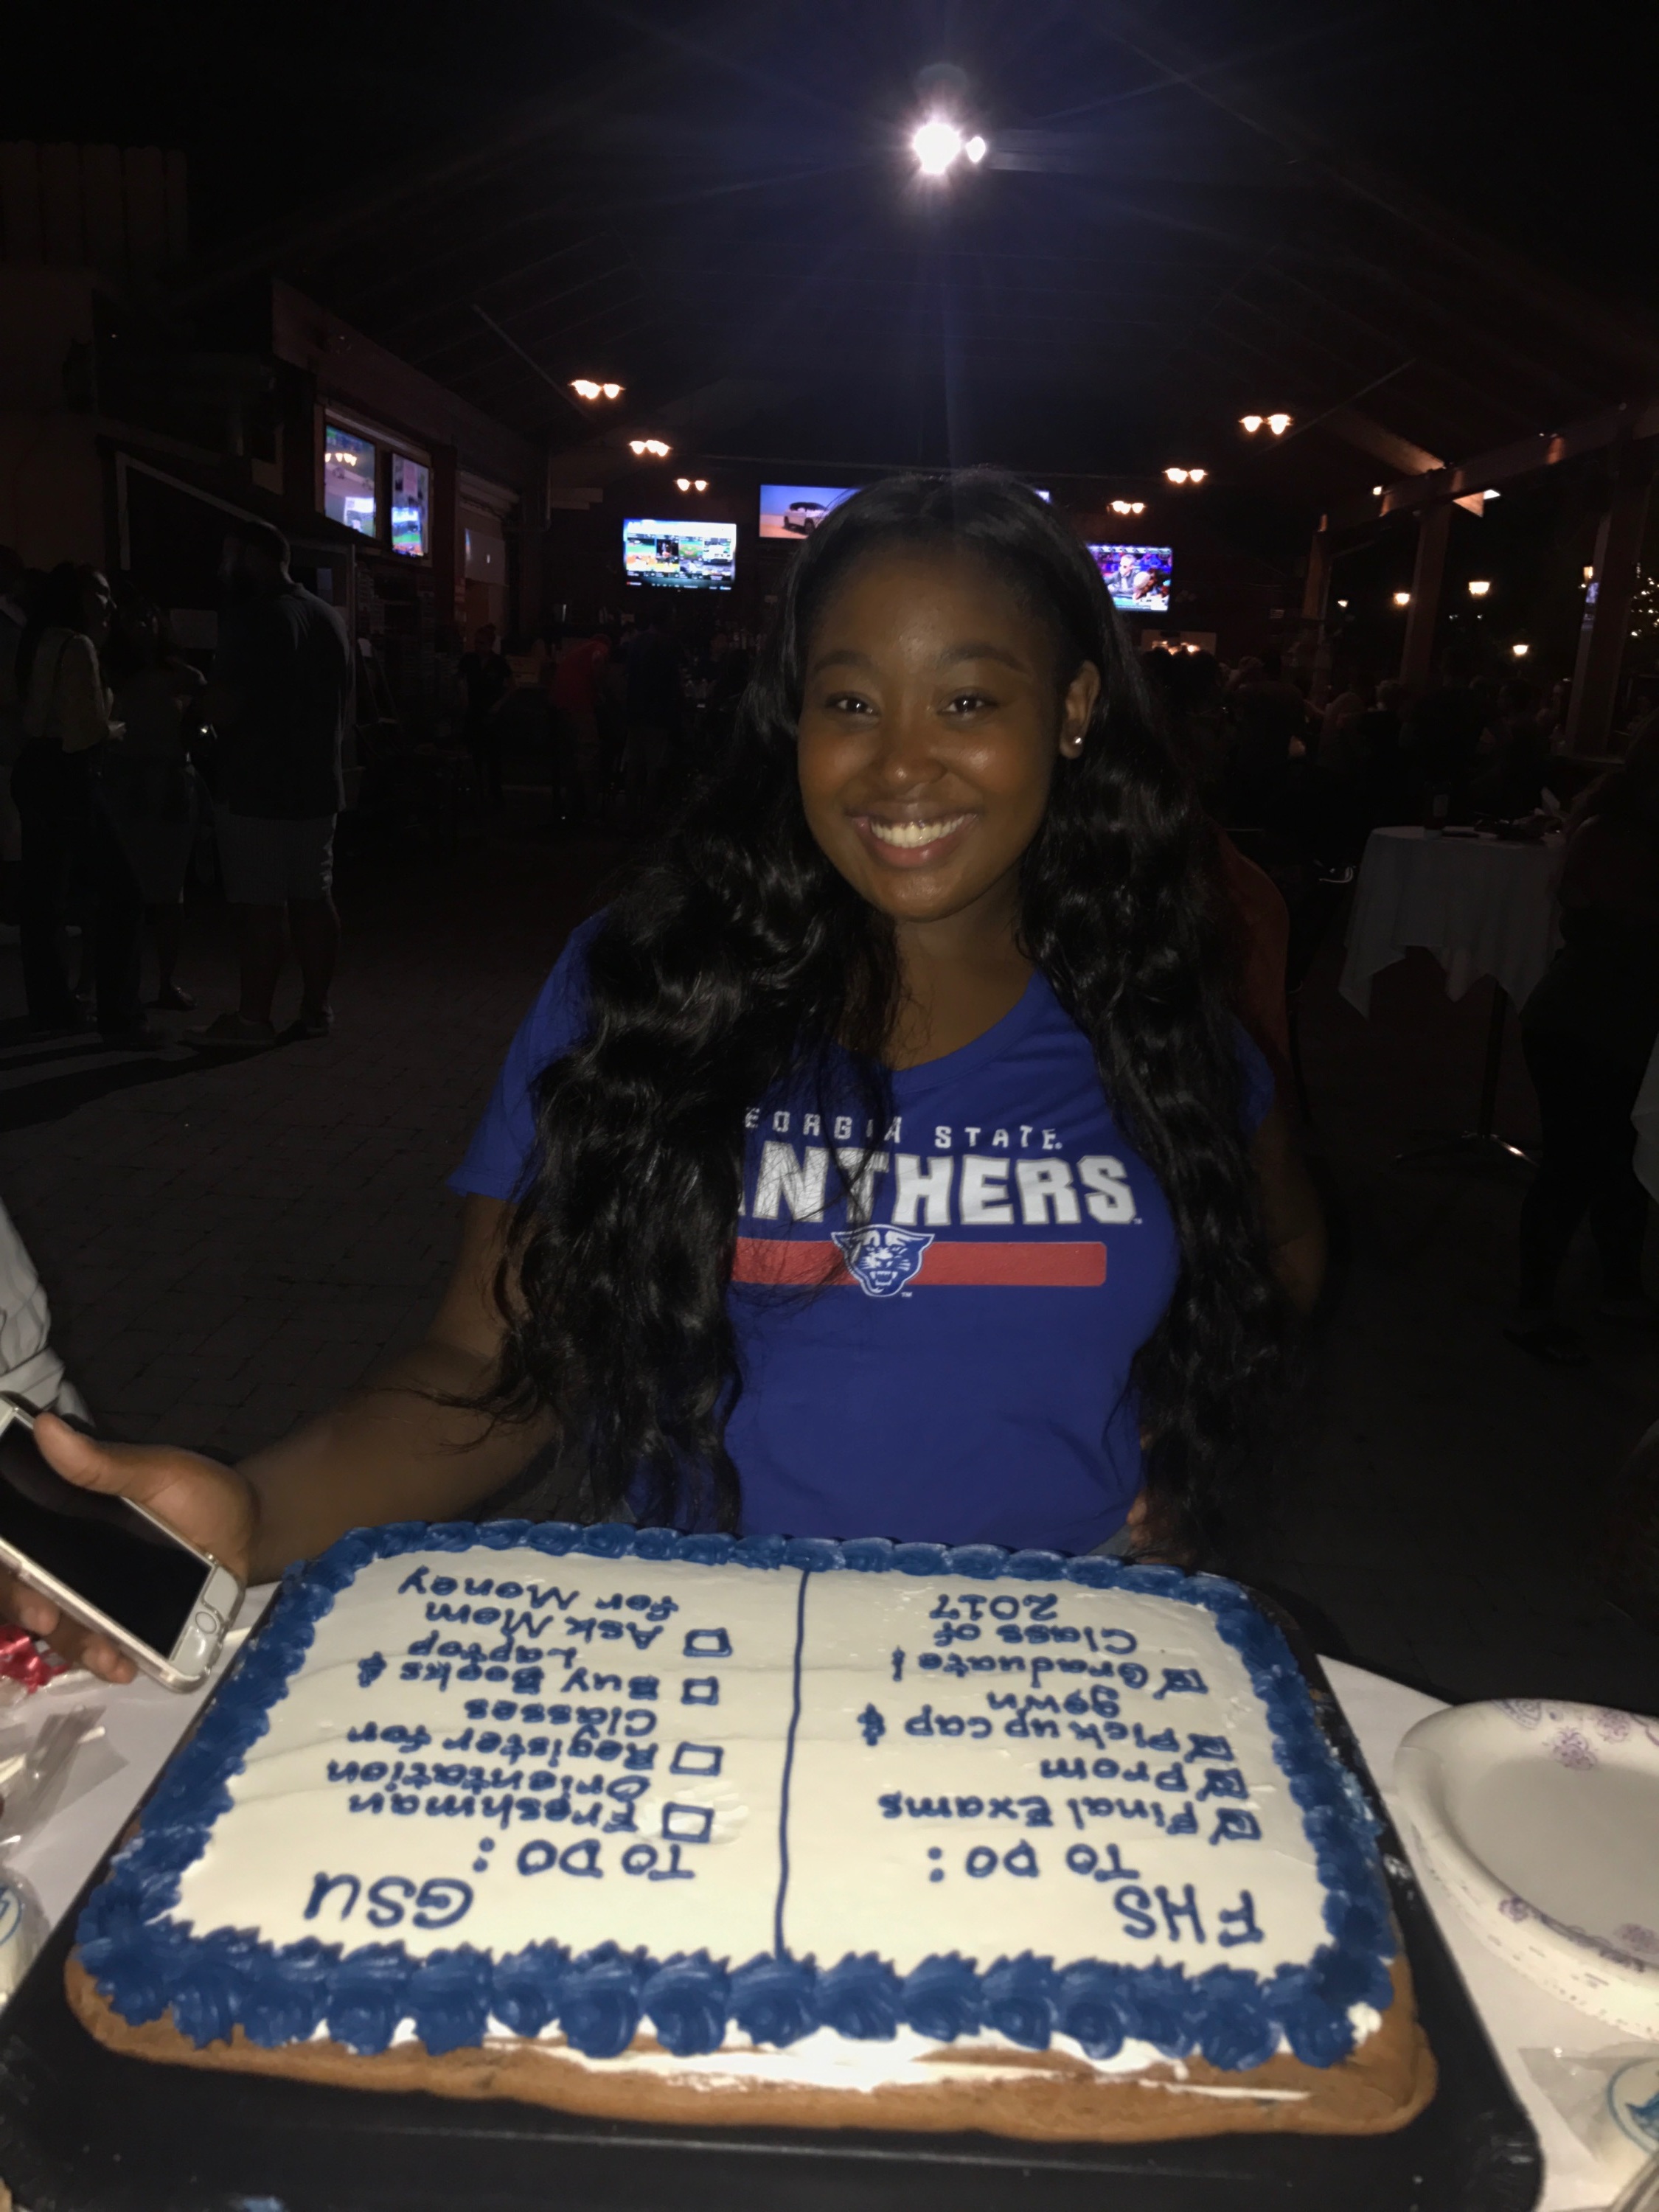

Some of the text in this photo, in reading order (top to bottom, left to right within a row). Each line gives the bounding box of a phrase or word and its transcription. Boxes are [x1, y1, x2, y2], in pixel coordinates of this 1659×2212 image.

[737, 1140, 1138, 1226] NTHERS
[397, 1565, 680, 1620] for Money
[929, 1592, 1058, 1621] 2017
[425, 1601, 664, 1650] Ask Mom
[933, 1621, 1137, 1655] Class of
[408, 1628, 577, 1667] Laptop
[400, 1658, 545, 1694] Books
[561, 1666, 660, 1700] Buy
[464, 1697, 658, 1737] Classes
[987, 1685, 1120, 1717] gown
[904, 1705, 992, 1739] cap
[1004, 1708, 1060, 1739] up
[1068, 1719, 1180, 1751] Pick
[347, 1722, 660, 1770] Register for
[327, 1760, 650, 1801] Orientation
[1040, 1756, 1188, 1792] Prom
[347, 1793, 639, 1833] Freshman
[877, 1791, 1198, 1835] Final Exams
[620, 1842, 696, 1881] TO
[1065, 1843, 1140, 1882] TO
[303, 1871, 475, 1930] GSU
